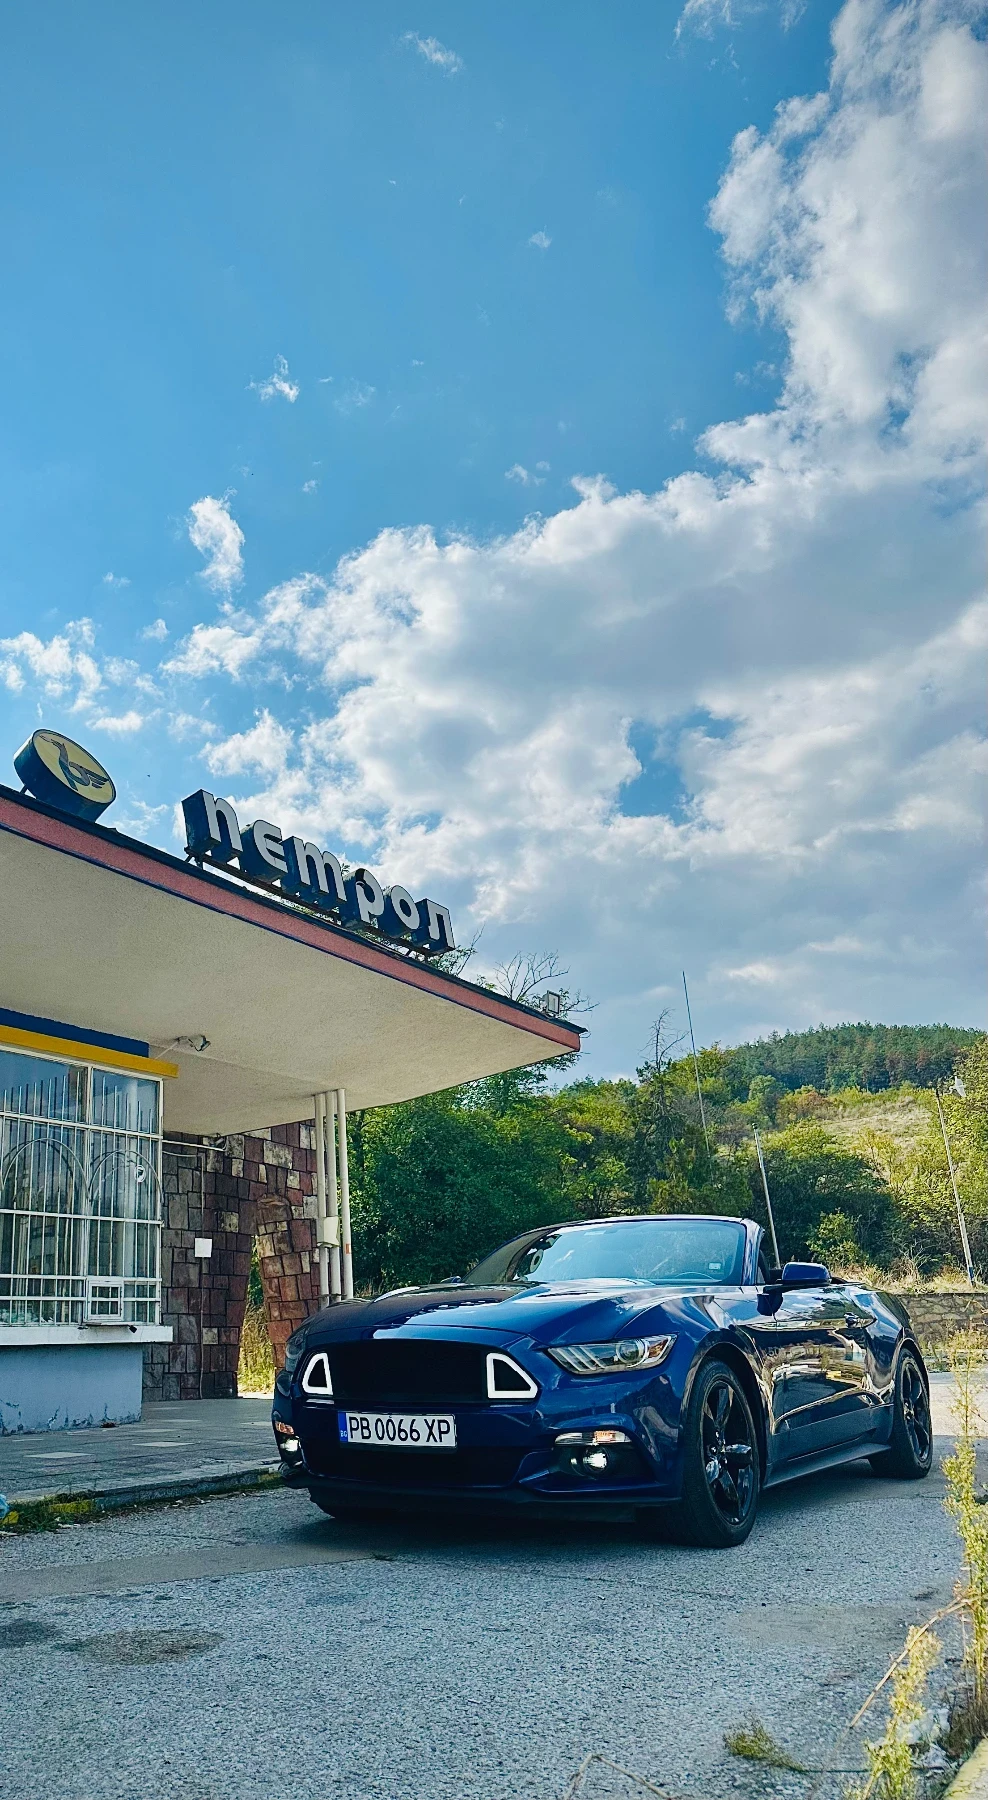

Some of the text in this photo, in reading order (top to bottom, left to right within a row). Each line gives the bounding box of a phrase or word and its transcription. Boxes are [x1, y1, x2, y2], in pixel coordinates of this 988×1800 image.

[348, 1416, 451, 1443] PB 0066 XP
